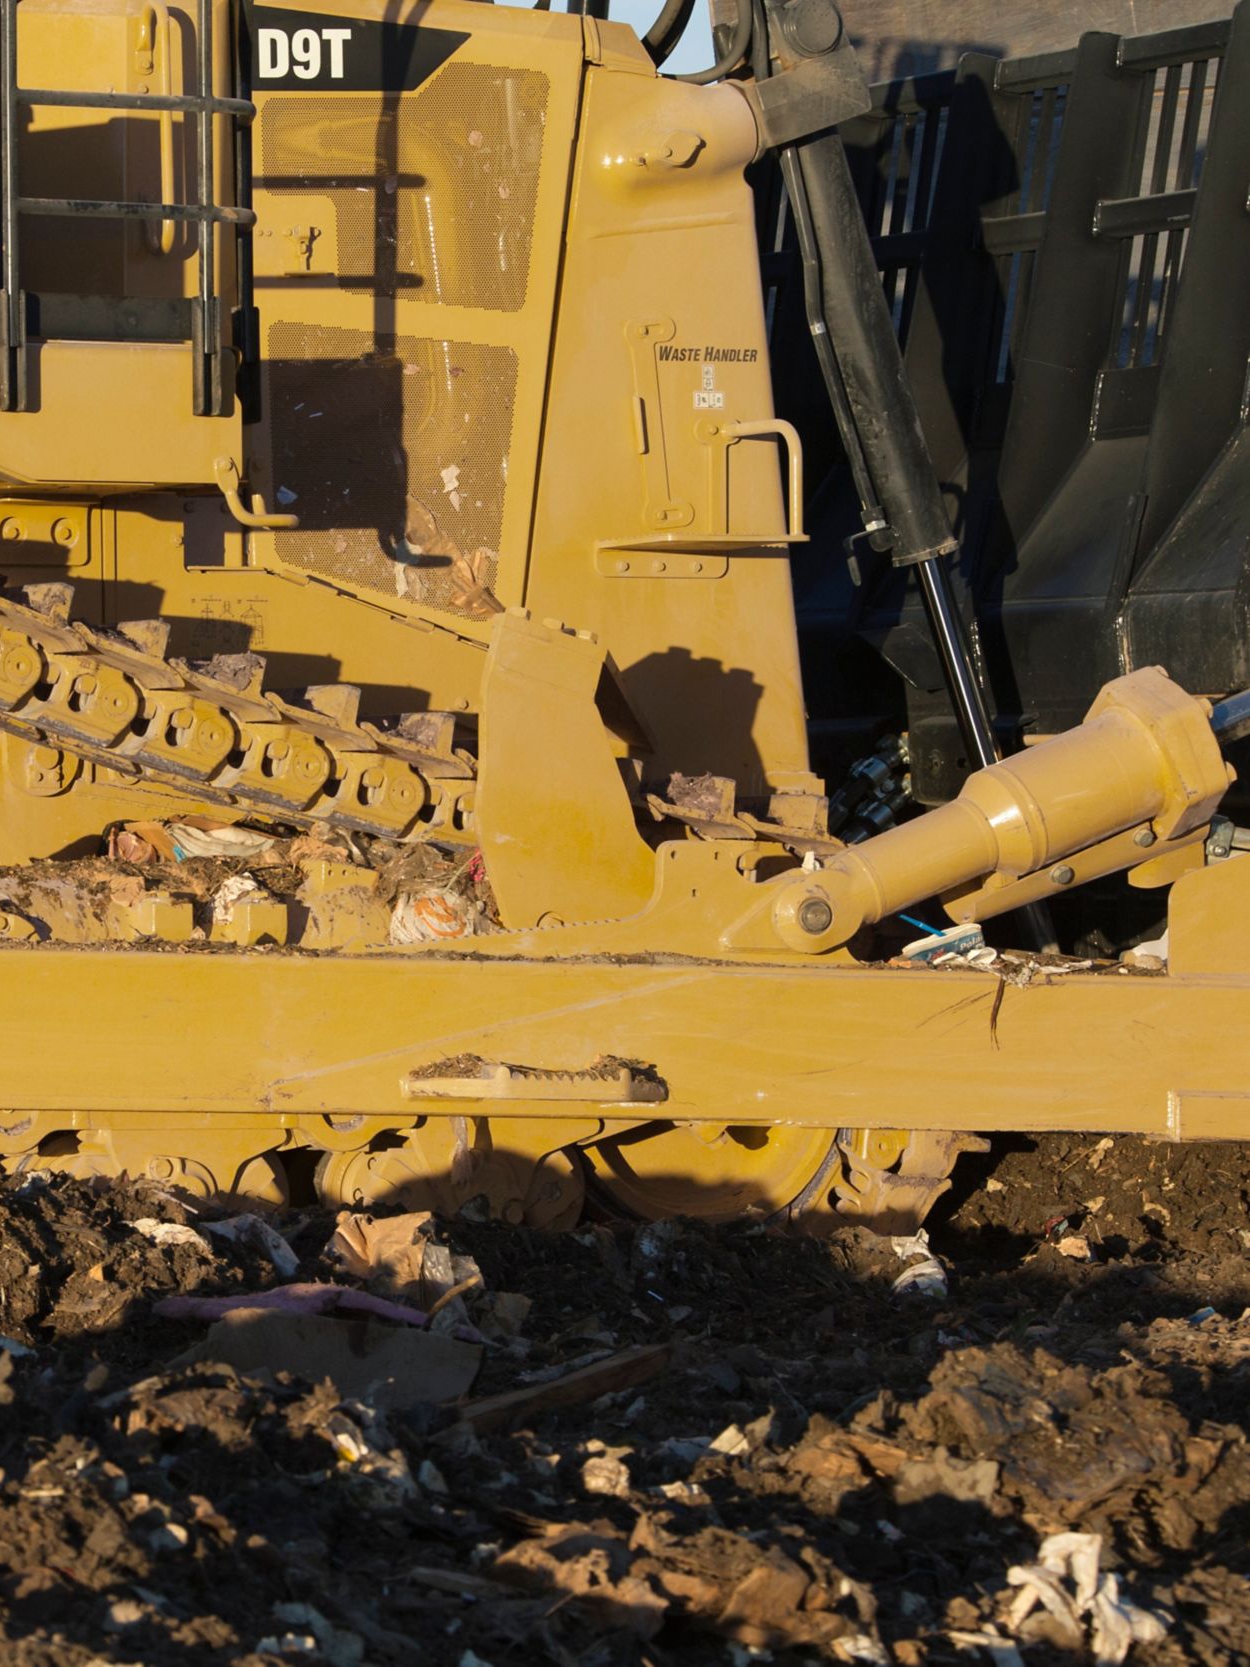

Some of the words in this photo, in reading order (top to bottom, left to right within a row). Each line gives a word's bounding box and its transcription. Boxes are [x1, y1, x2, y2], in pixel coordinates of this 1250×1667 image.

[258, 28, 351, 80] D9T
[659, 346, 701, 361] WASTE
[704, 347, 758, 362] HANDLER
